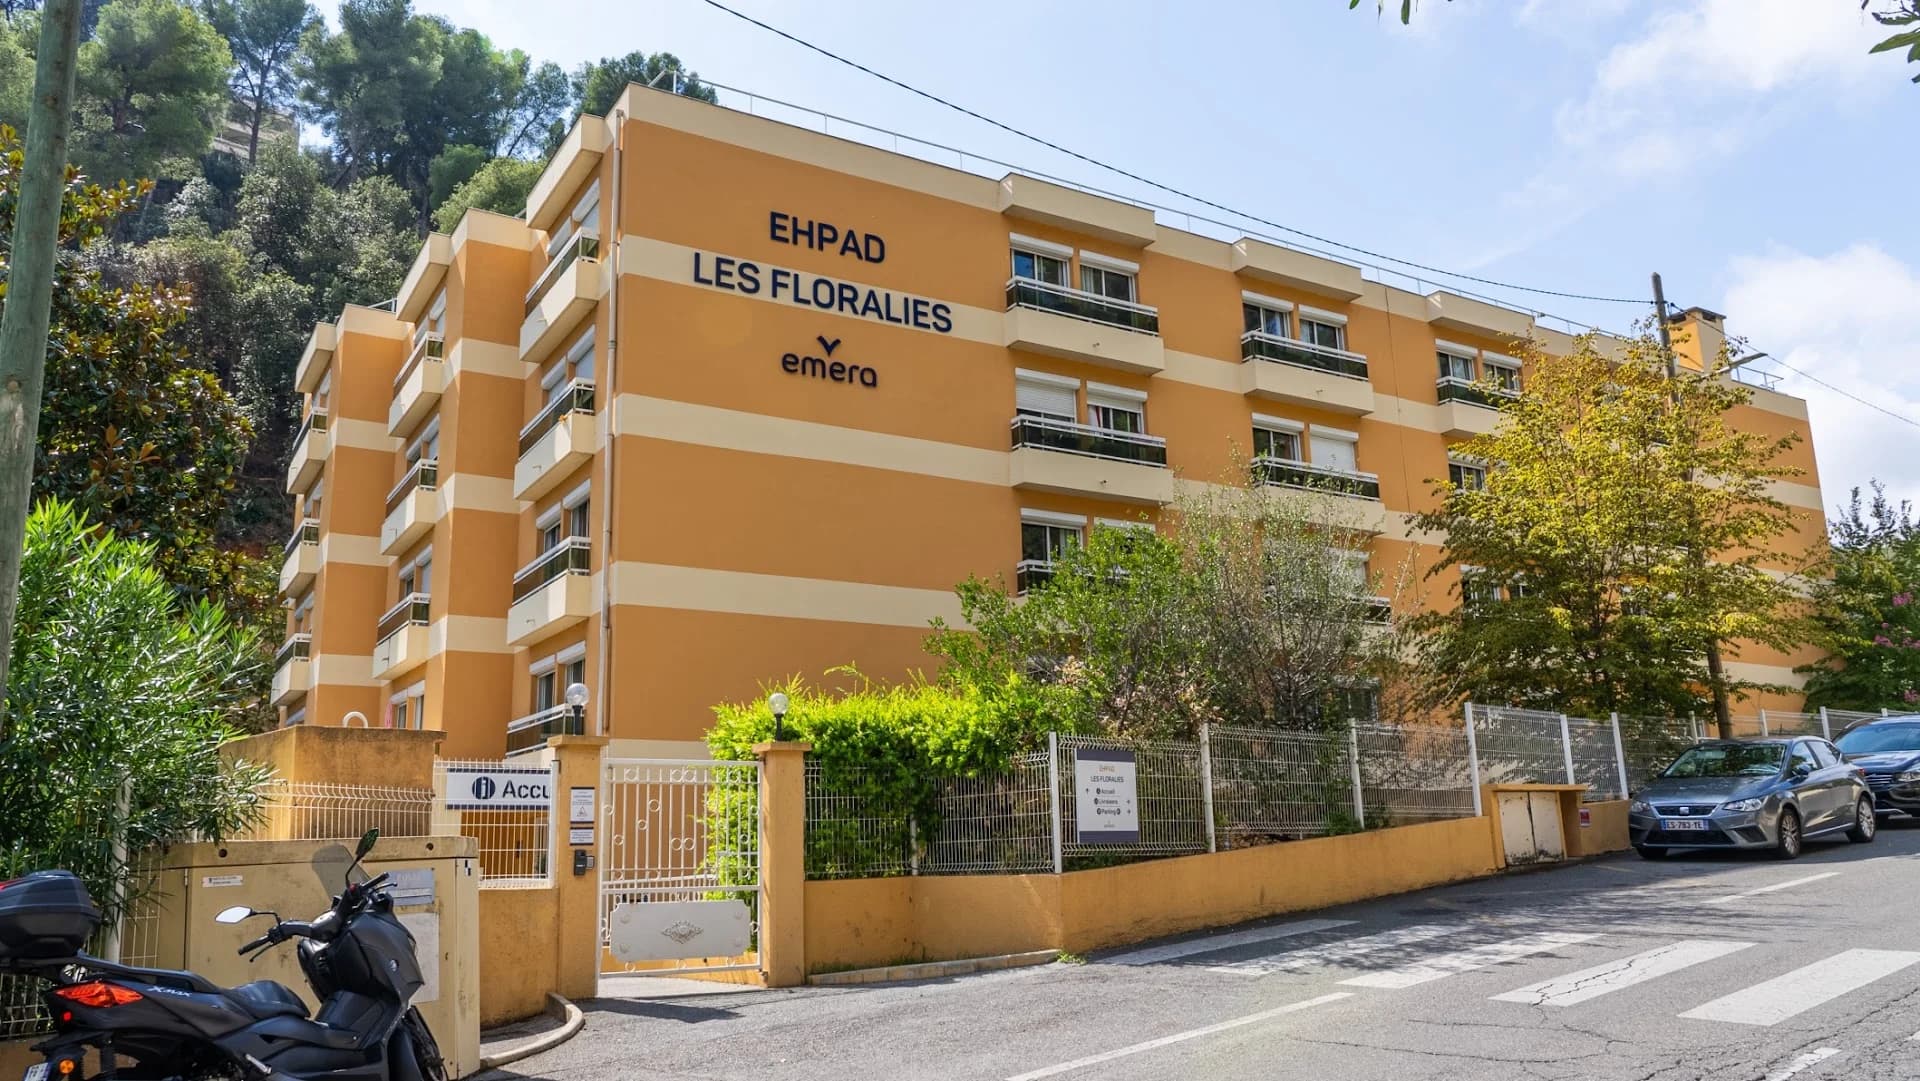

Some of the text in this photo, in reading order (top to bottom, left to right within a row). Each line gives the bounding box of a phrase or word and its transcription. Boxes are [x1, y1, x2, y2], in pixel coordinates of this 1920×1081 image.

[770, 211, 885, 264] EHPAD
[694, 252, 952, 333] LES FLORALIES
[781, 352, 878, 388] emera
[1100, 775, 1124, 783] FLORALIES
